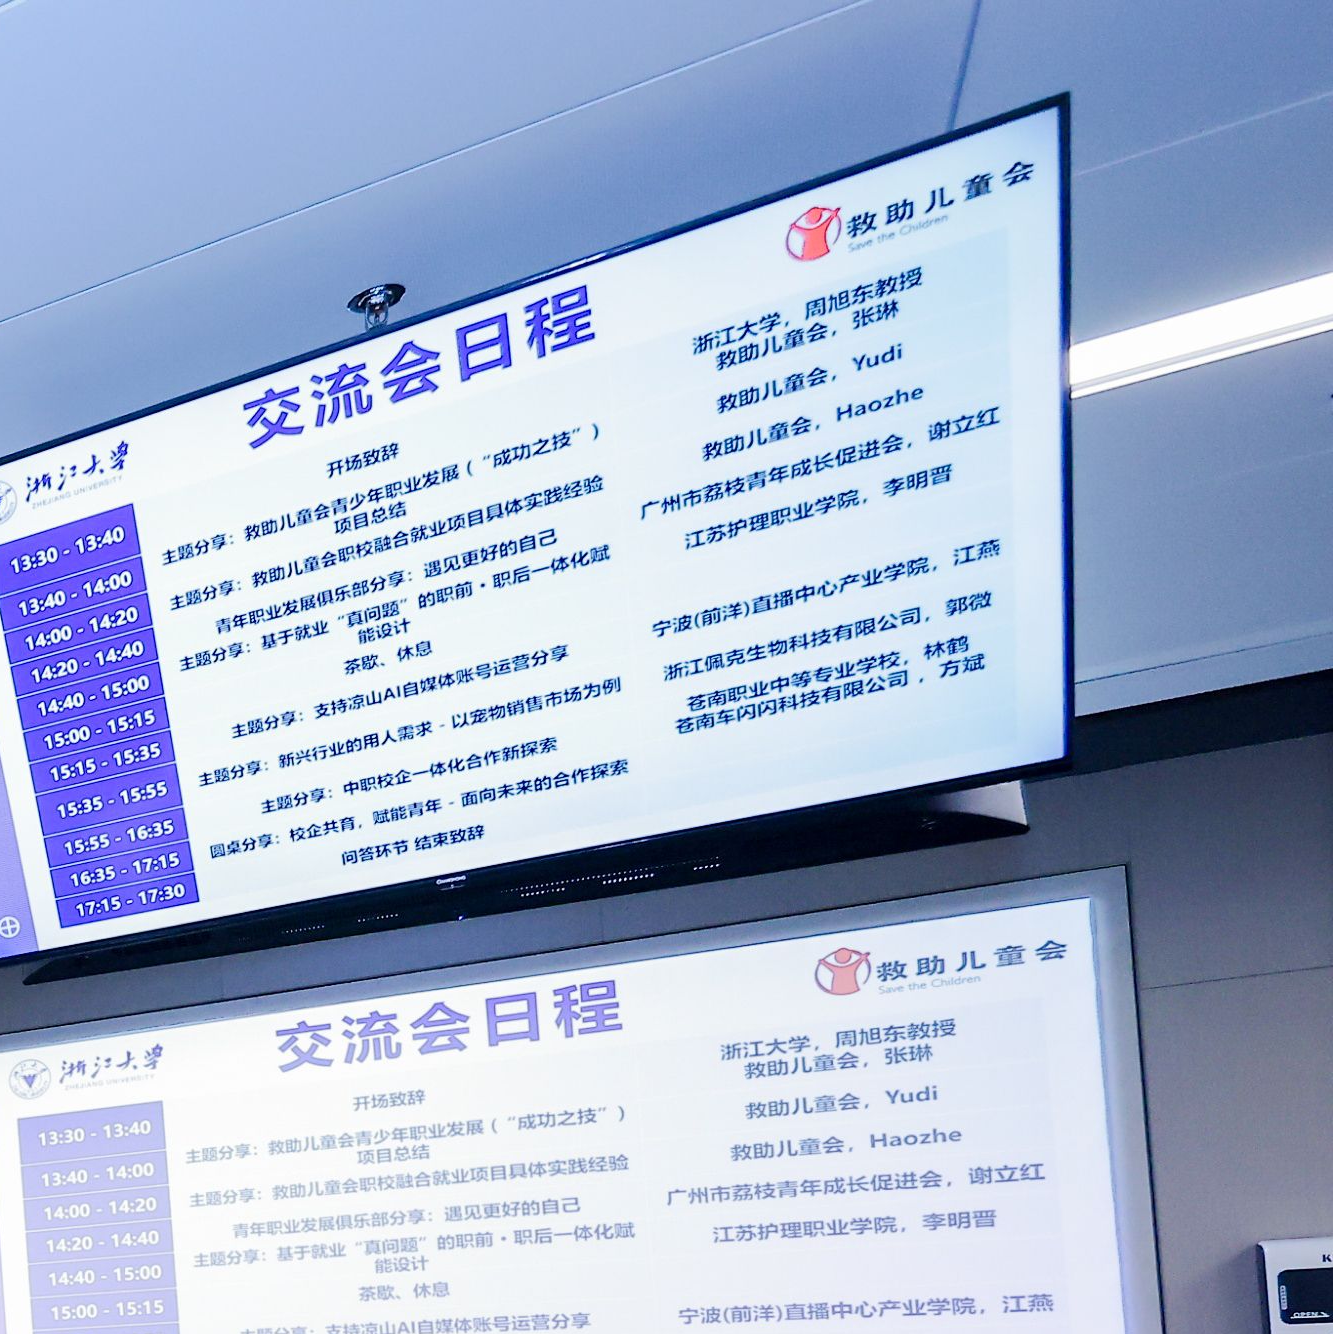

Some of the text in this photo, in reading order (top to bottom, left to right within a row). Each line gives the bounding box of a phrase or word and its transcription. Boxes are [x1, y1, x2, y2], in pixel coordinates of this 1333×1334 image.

[847, 161, 1034, 238] 救助儿童会
[848, 214, 949, 252] Save the Children
[242, 284, 596, 450] 交流会日程
[327, 442, 399, 479] 开场致辞
[333, 501, 407, 535] 项目总结
[10, 526, 125, 574] 13:30 13:40
[18, 570, 132, 616] 13:40 14:00
[25, 606, 138, 651] 14:00 14:20
[357, 617, 411, 645] 能设计
[31, 640, 144, 683] 14:20 14:40
[343, 640, 433, 675] 茶歇、休息
[37, 675, 150, 717] 14:40 15:00
[451, 676, 621, 729] 以宠物销售市场为例
[43, 709, 156, 750] 15:00 15:15
[50, 742, 161, 782] 15:15 15:35
[57, 781, 168, 819] 15:35 15:55
[461, 759, 629, 808] 面向未来的合作探索
[64, 819, 174, 855] 15:55 16:35
[341, 824, 485, 866] 问答环节 结束致辞
[70, 852, 180, 887] 16:35 17:15
[75, 883, 186, 917] 17:15 17:30
[876, 940, 1067, 983] 救助儿童会
[878, 975, 982, 995] Save the Children
[275, 979, 623, 1073] 交流会日程
[38, 1120, 151, 1146] 13:30 13:40
[41, 1162, 155, 1187] 13:40 14:00
[43, 1196, 157, 1221] 14:00 14:20
[46, 1230, 160, 1253] 14:20 14:40
[48, 1264, 162, 1287] 14:40 15:00
[50, 1299, 164, 1321] 15:00 15:15
